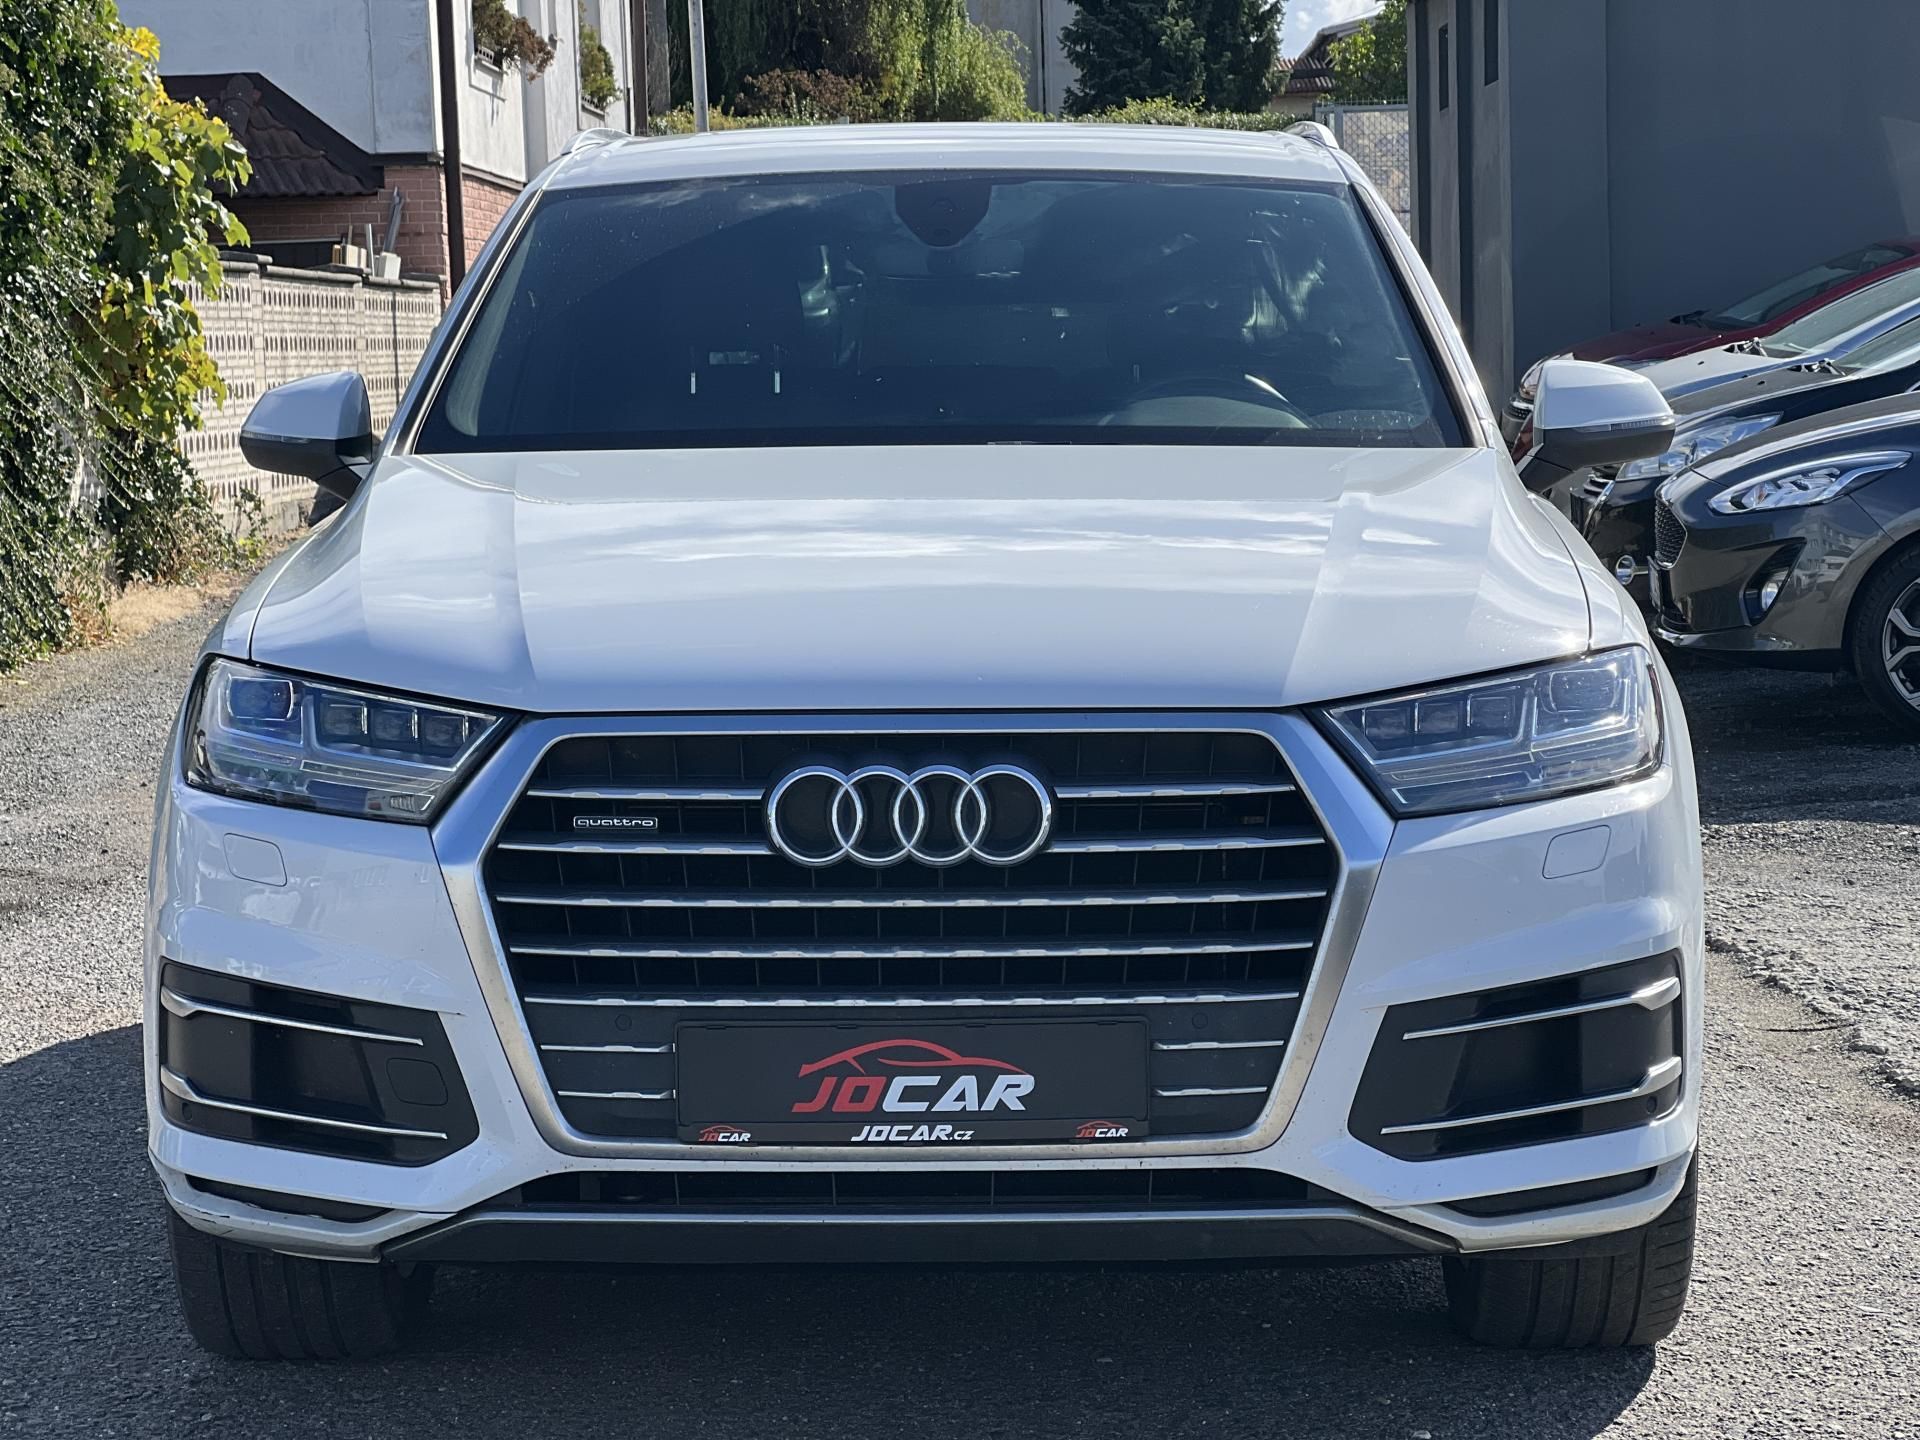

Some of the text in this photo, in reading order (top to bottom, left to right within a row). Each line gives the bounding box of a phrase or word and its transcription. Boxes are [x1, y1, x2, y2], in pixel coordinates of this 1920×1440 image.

[577, 818, 654, 827] quattro
[792, 1075, 1035, 1112] JOCAR
[699, 1132, 751, 1142] JOCAR
[851, 1125, 975, 1142] JOCAR.cz
[1075, 1128, 1129, 1138] JOCAR
